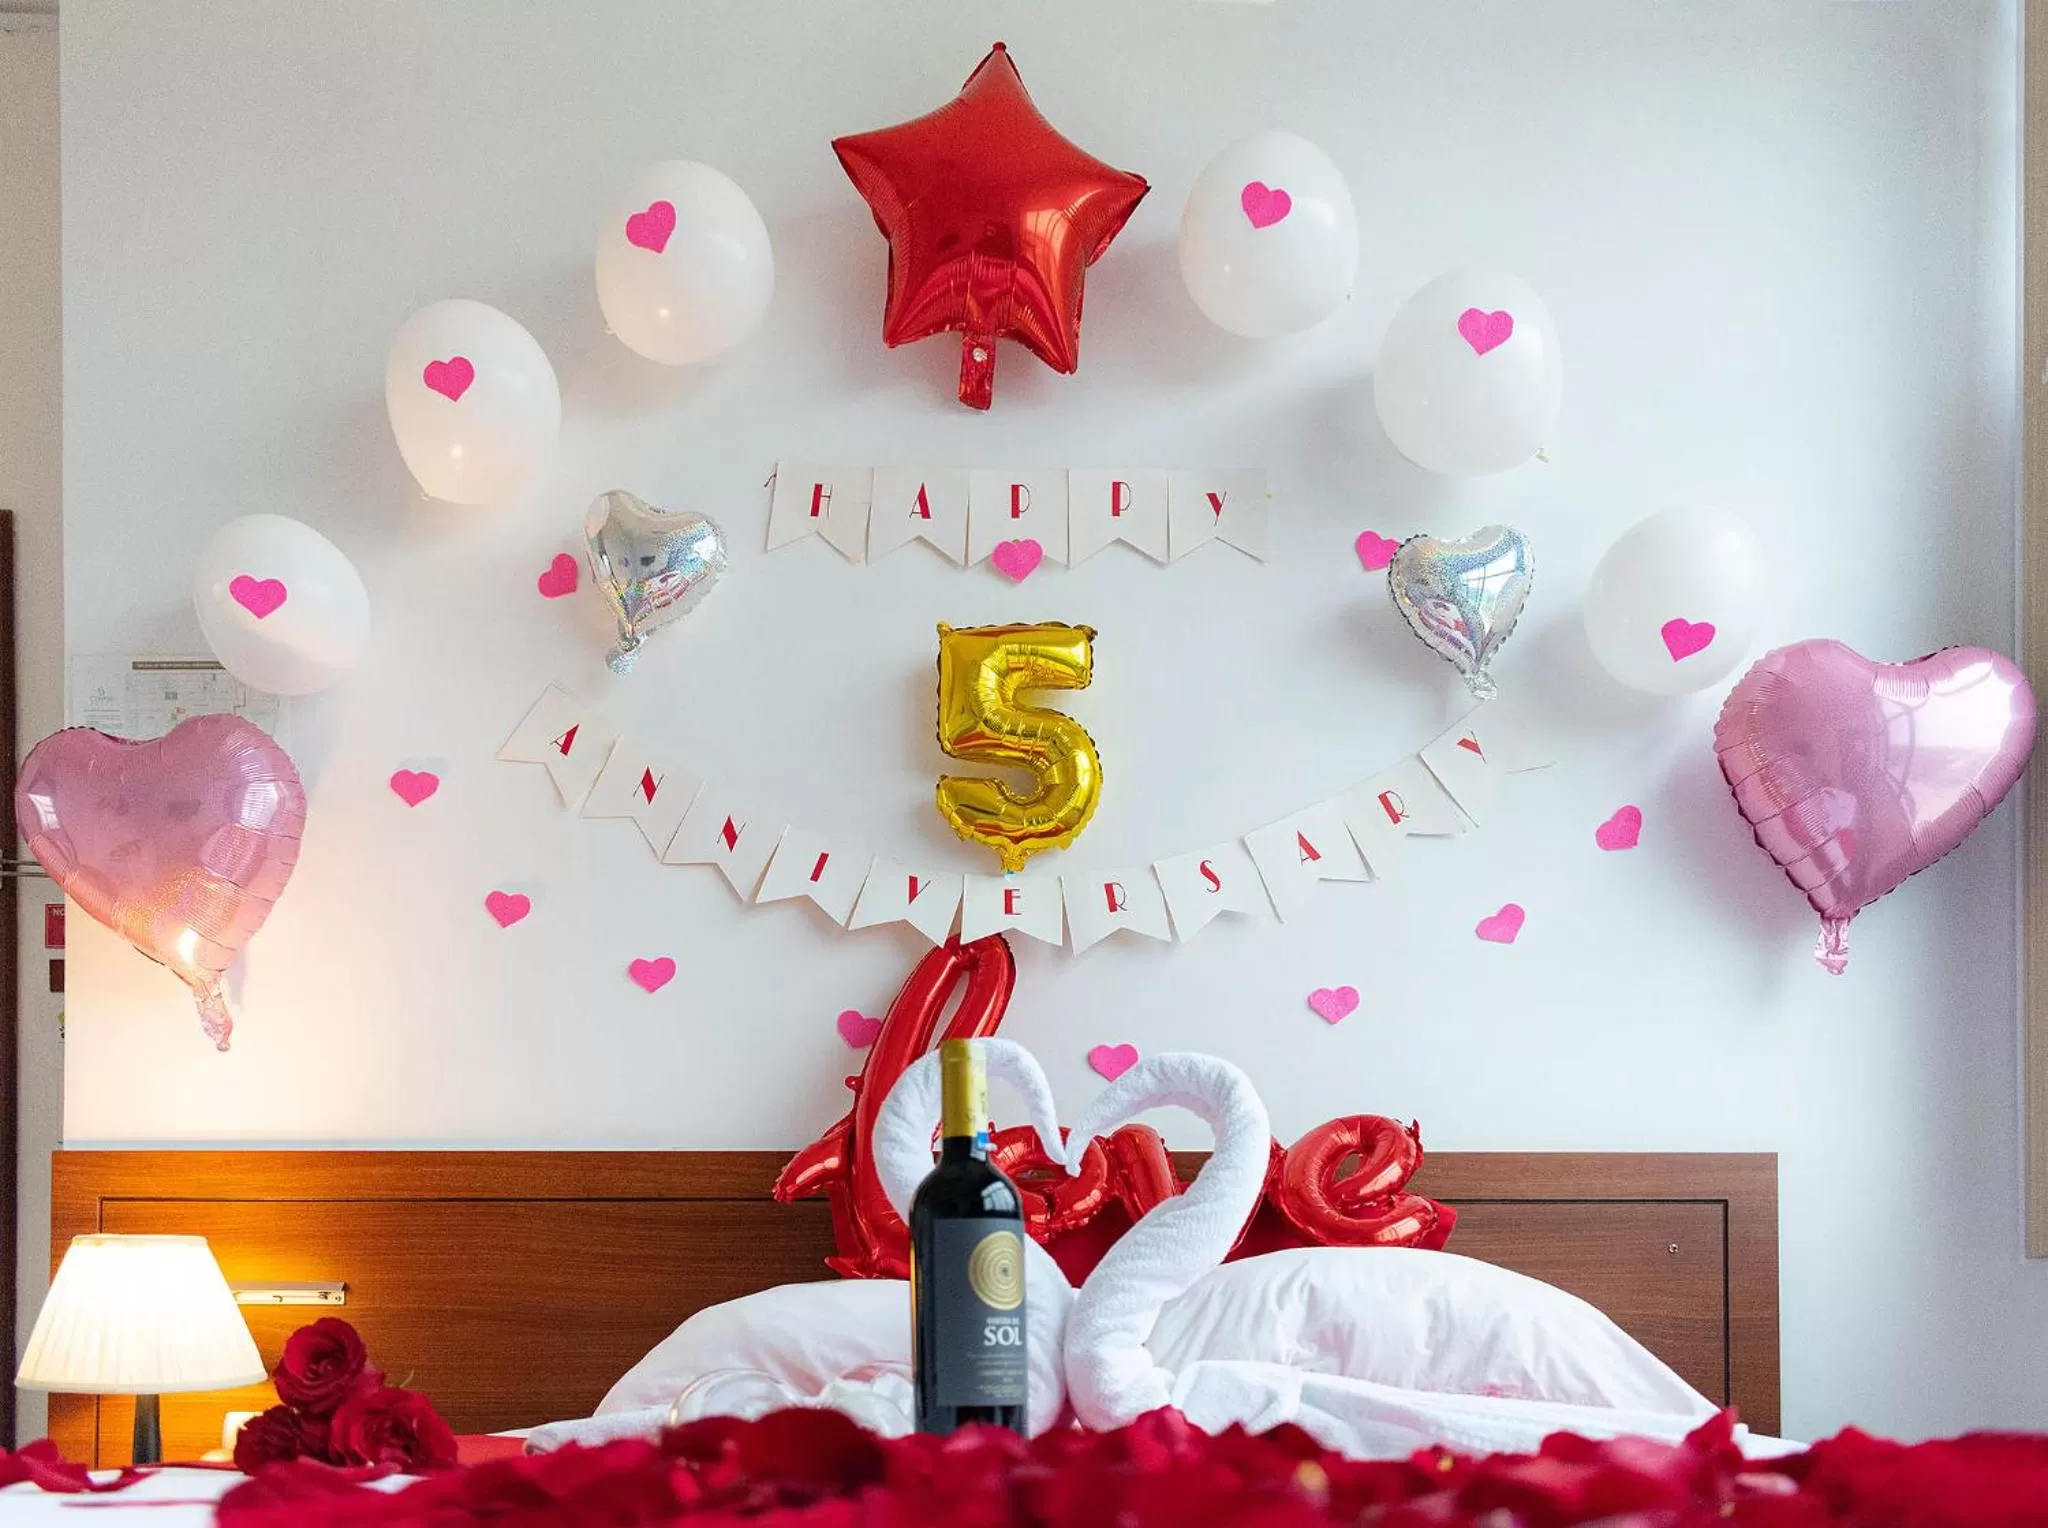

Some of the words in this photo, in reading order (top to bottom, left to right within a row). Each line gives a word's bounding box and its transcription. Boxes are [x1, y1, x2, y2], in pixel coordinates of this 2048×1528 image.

[810, 481, 1227, 526] HAPPY
[936, 620, 1102, 870] 5
[549, 723, 1487, 916] ANNIVERSARY
[983, 1325, 1023, 1346] SOL
